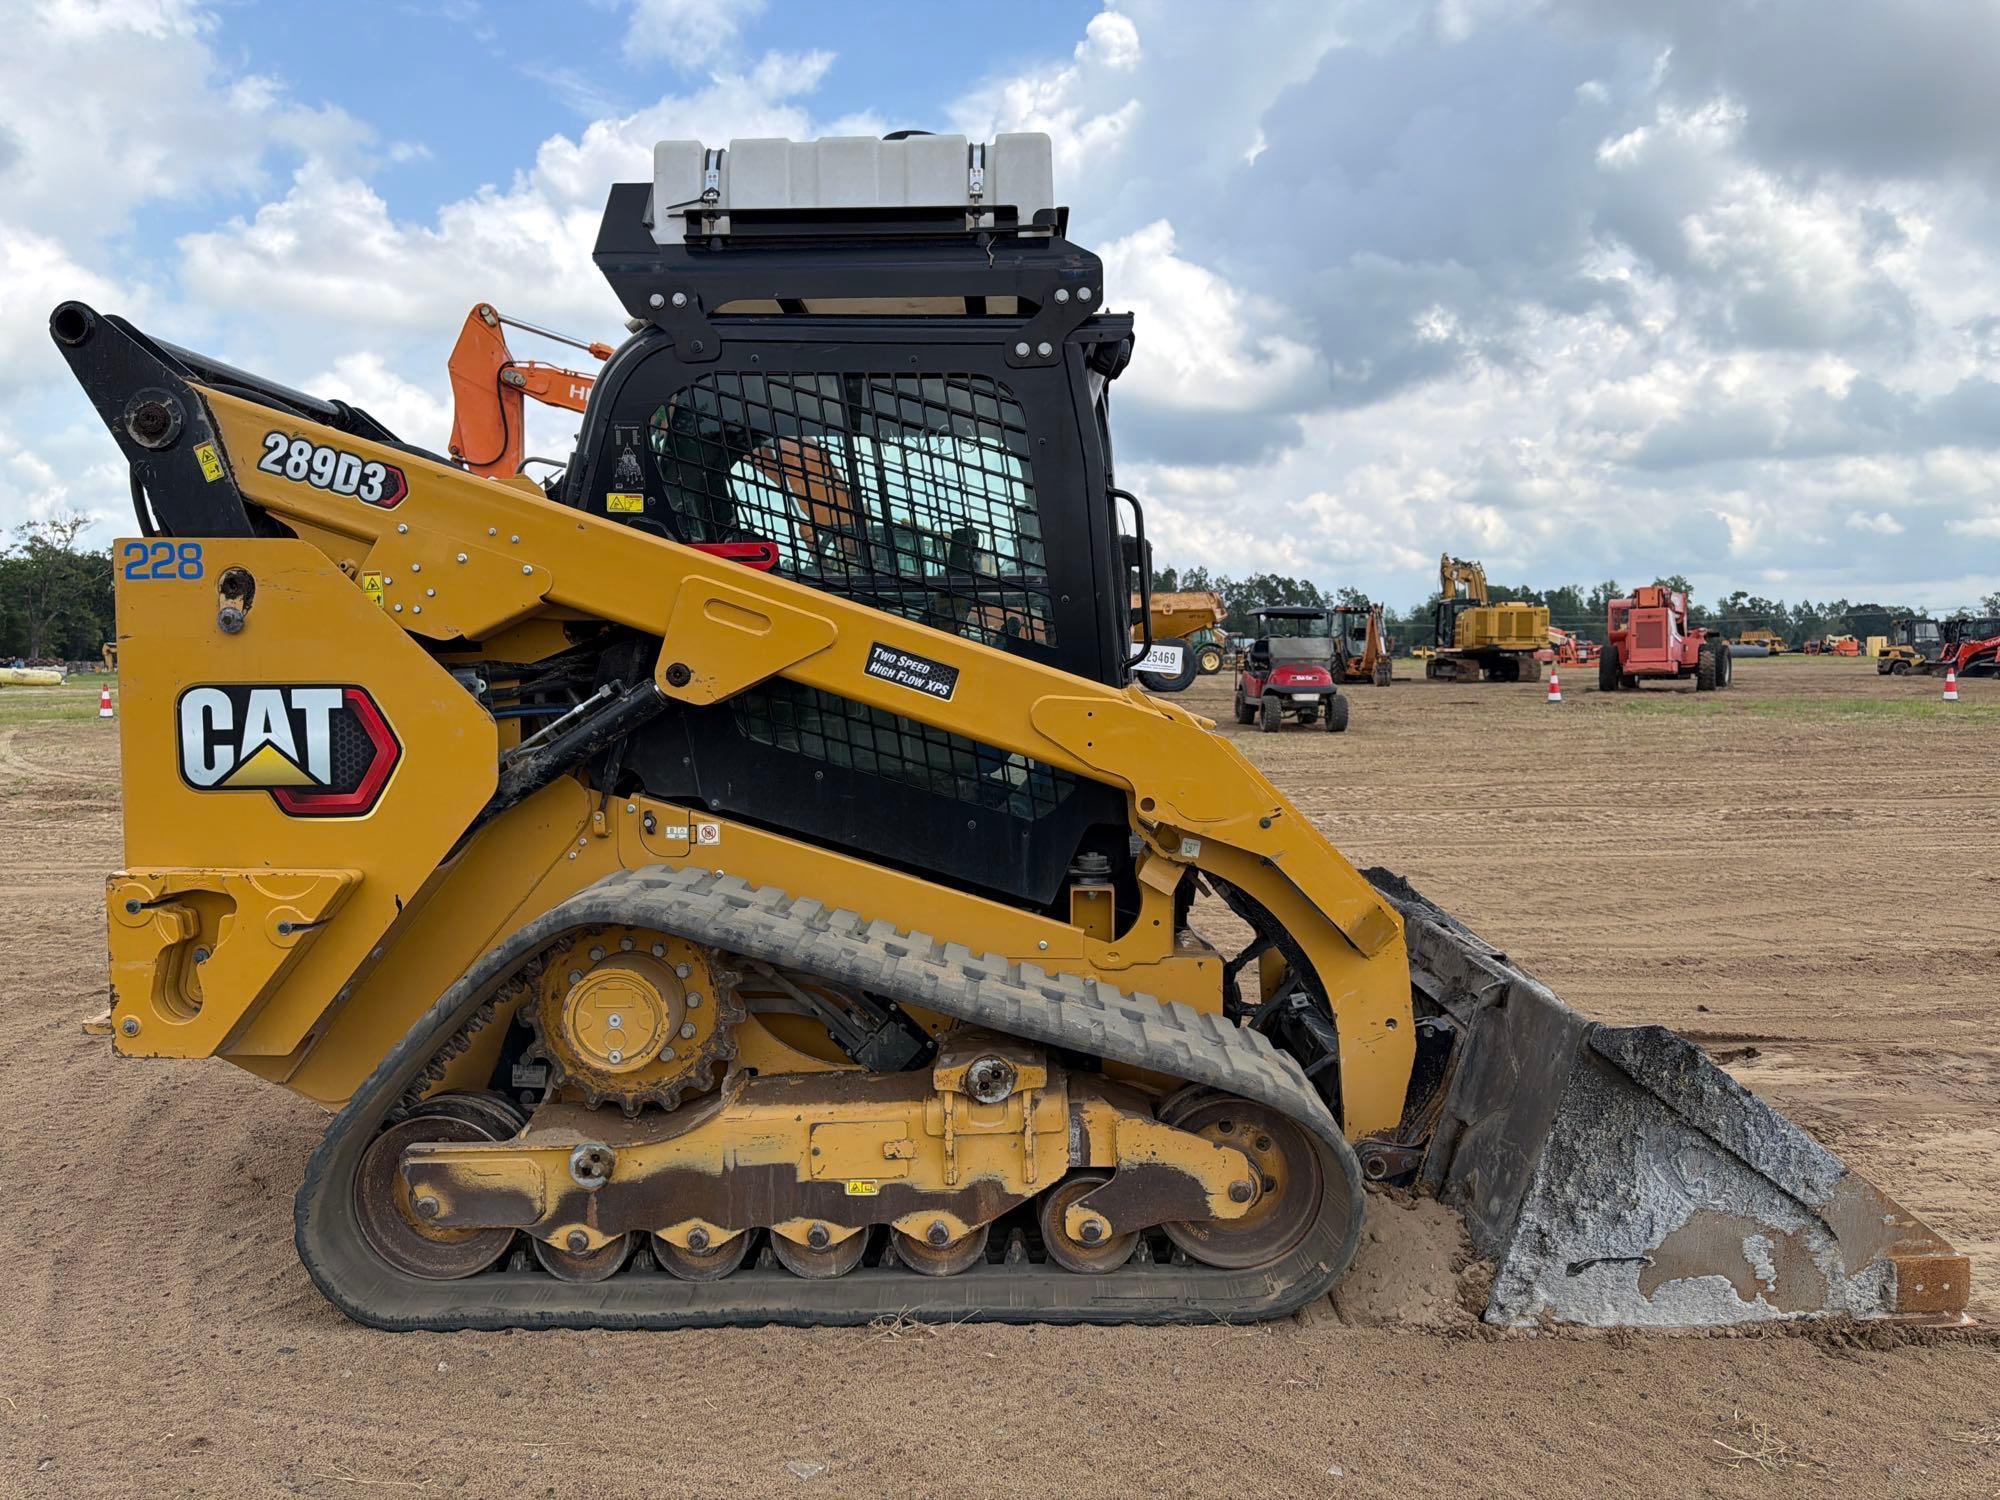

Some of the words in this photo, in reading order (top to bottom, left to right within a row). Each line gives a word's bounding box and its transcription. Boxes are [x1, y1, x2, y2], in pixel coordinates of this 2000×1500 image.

[259, 433, 386, 501] 289D3
[124, 541, 204, 580] 228
[925, 680, 950, 695] XPS
[181, 687, 342, 787] CAT
